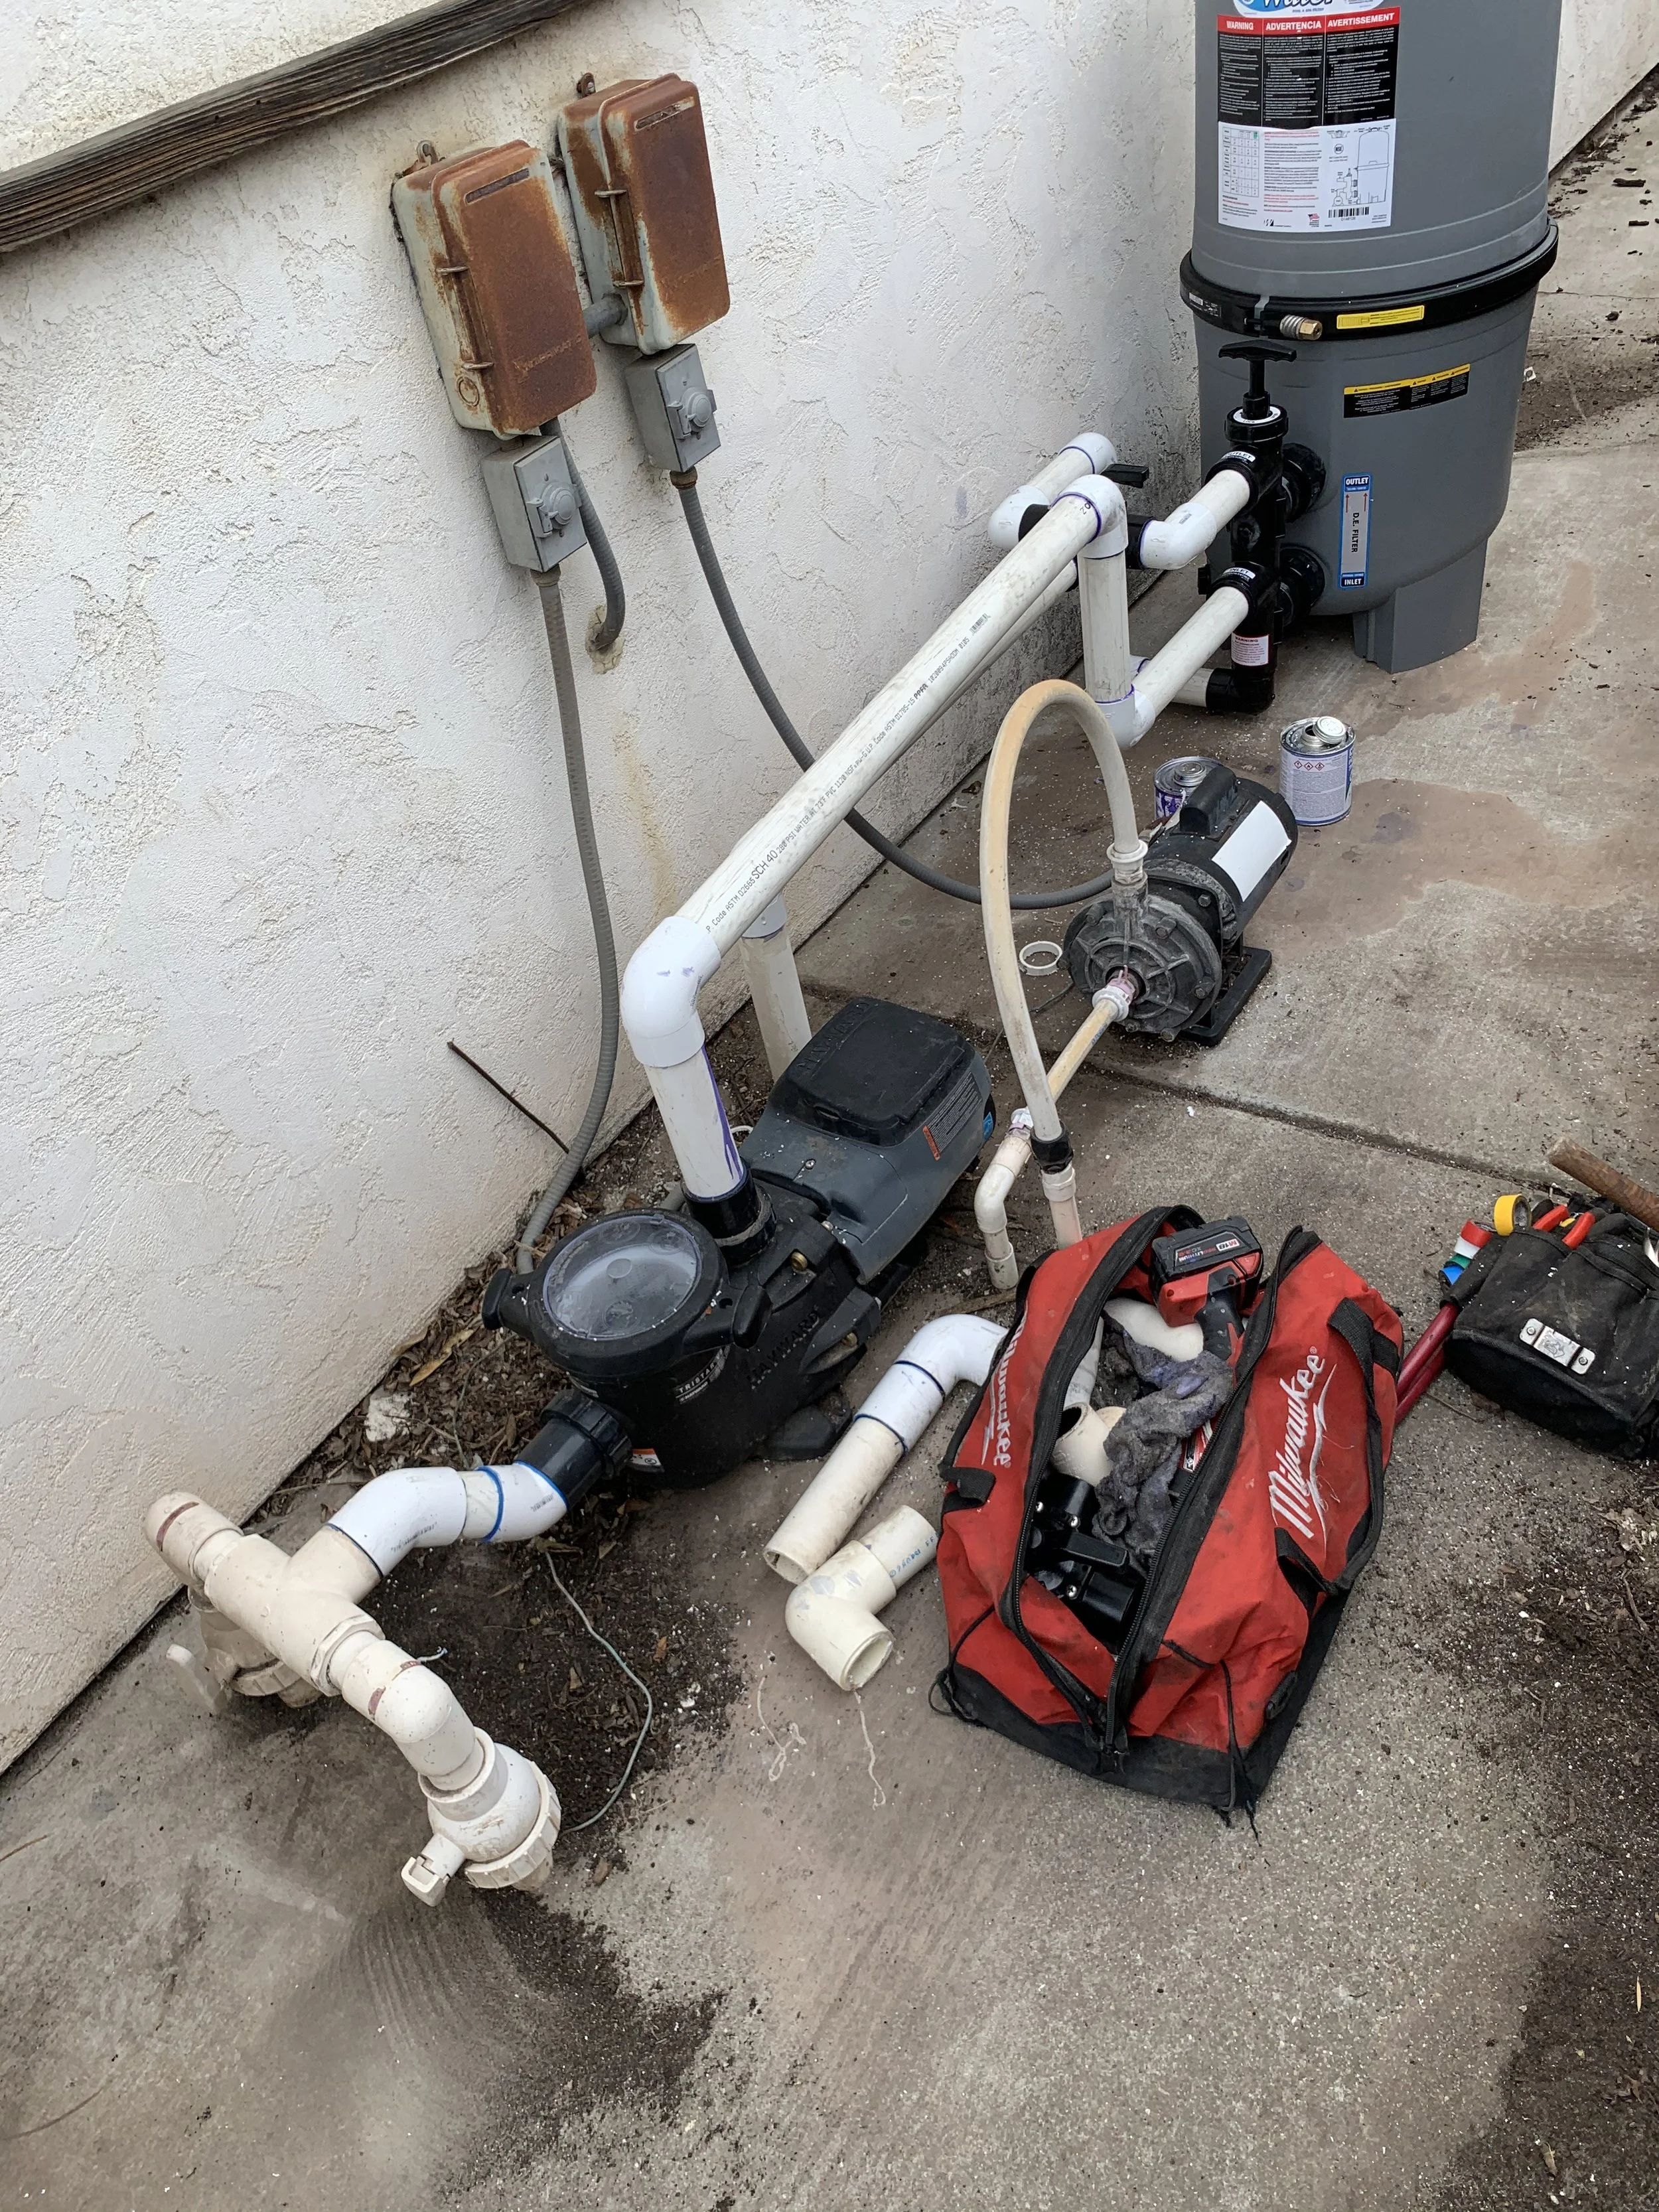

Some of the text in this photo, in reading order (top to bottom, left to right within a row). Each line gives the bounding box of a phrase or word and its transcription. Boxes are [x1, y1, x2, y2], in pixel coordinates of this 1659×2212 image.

[1226, 20, 1254, 31] WARNING
[1265, 21, 1321, 31] ADVERTENCIA
[1328, 13, 1394, 27] AVERTISSEMENT
[711, 910, 727, 926] Code
[725, 895, 741, 911] ASTM
[738, 877, 756, 897] D2665
[751, 860, 770, 880] SCH
[766, 849, 778, 863] 40
[786, 831, 797, 844] PSI
[794, 814, 811, 834] WATER
[809, 807, 818, 818] AT
[825, 786, 837, 798] PVC
[834, 774, 847, 788] 1120
[873, 731, 887, 745] Code
[884, 718, 897, 733] ASTM
[914, 683, 929, 700] PPFA
[1218, 1240, 1238, 1250] M18
[747, 1311, 820, 1390] HAYWARD
[678, 1361, 715, 1394] TRISTAR
[1268, 1355, 1325, 1539] Milwaukee
